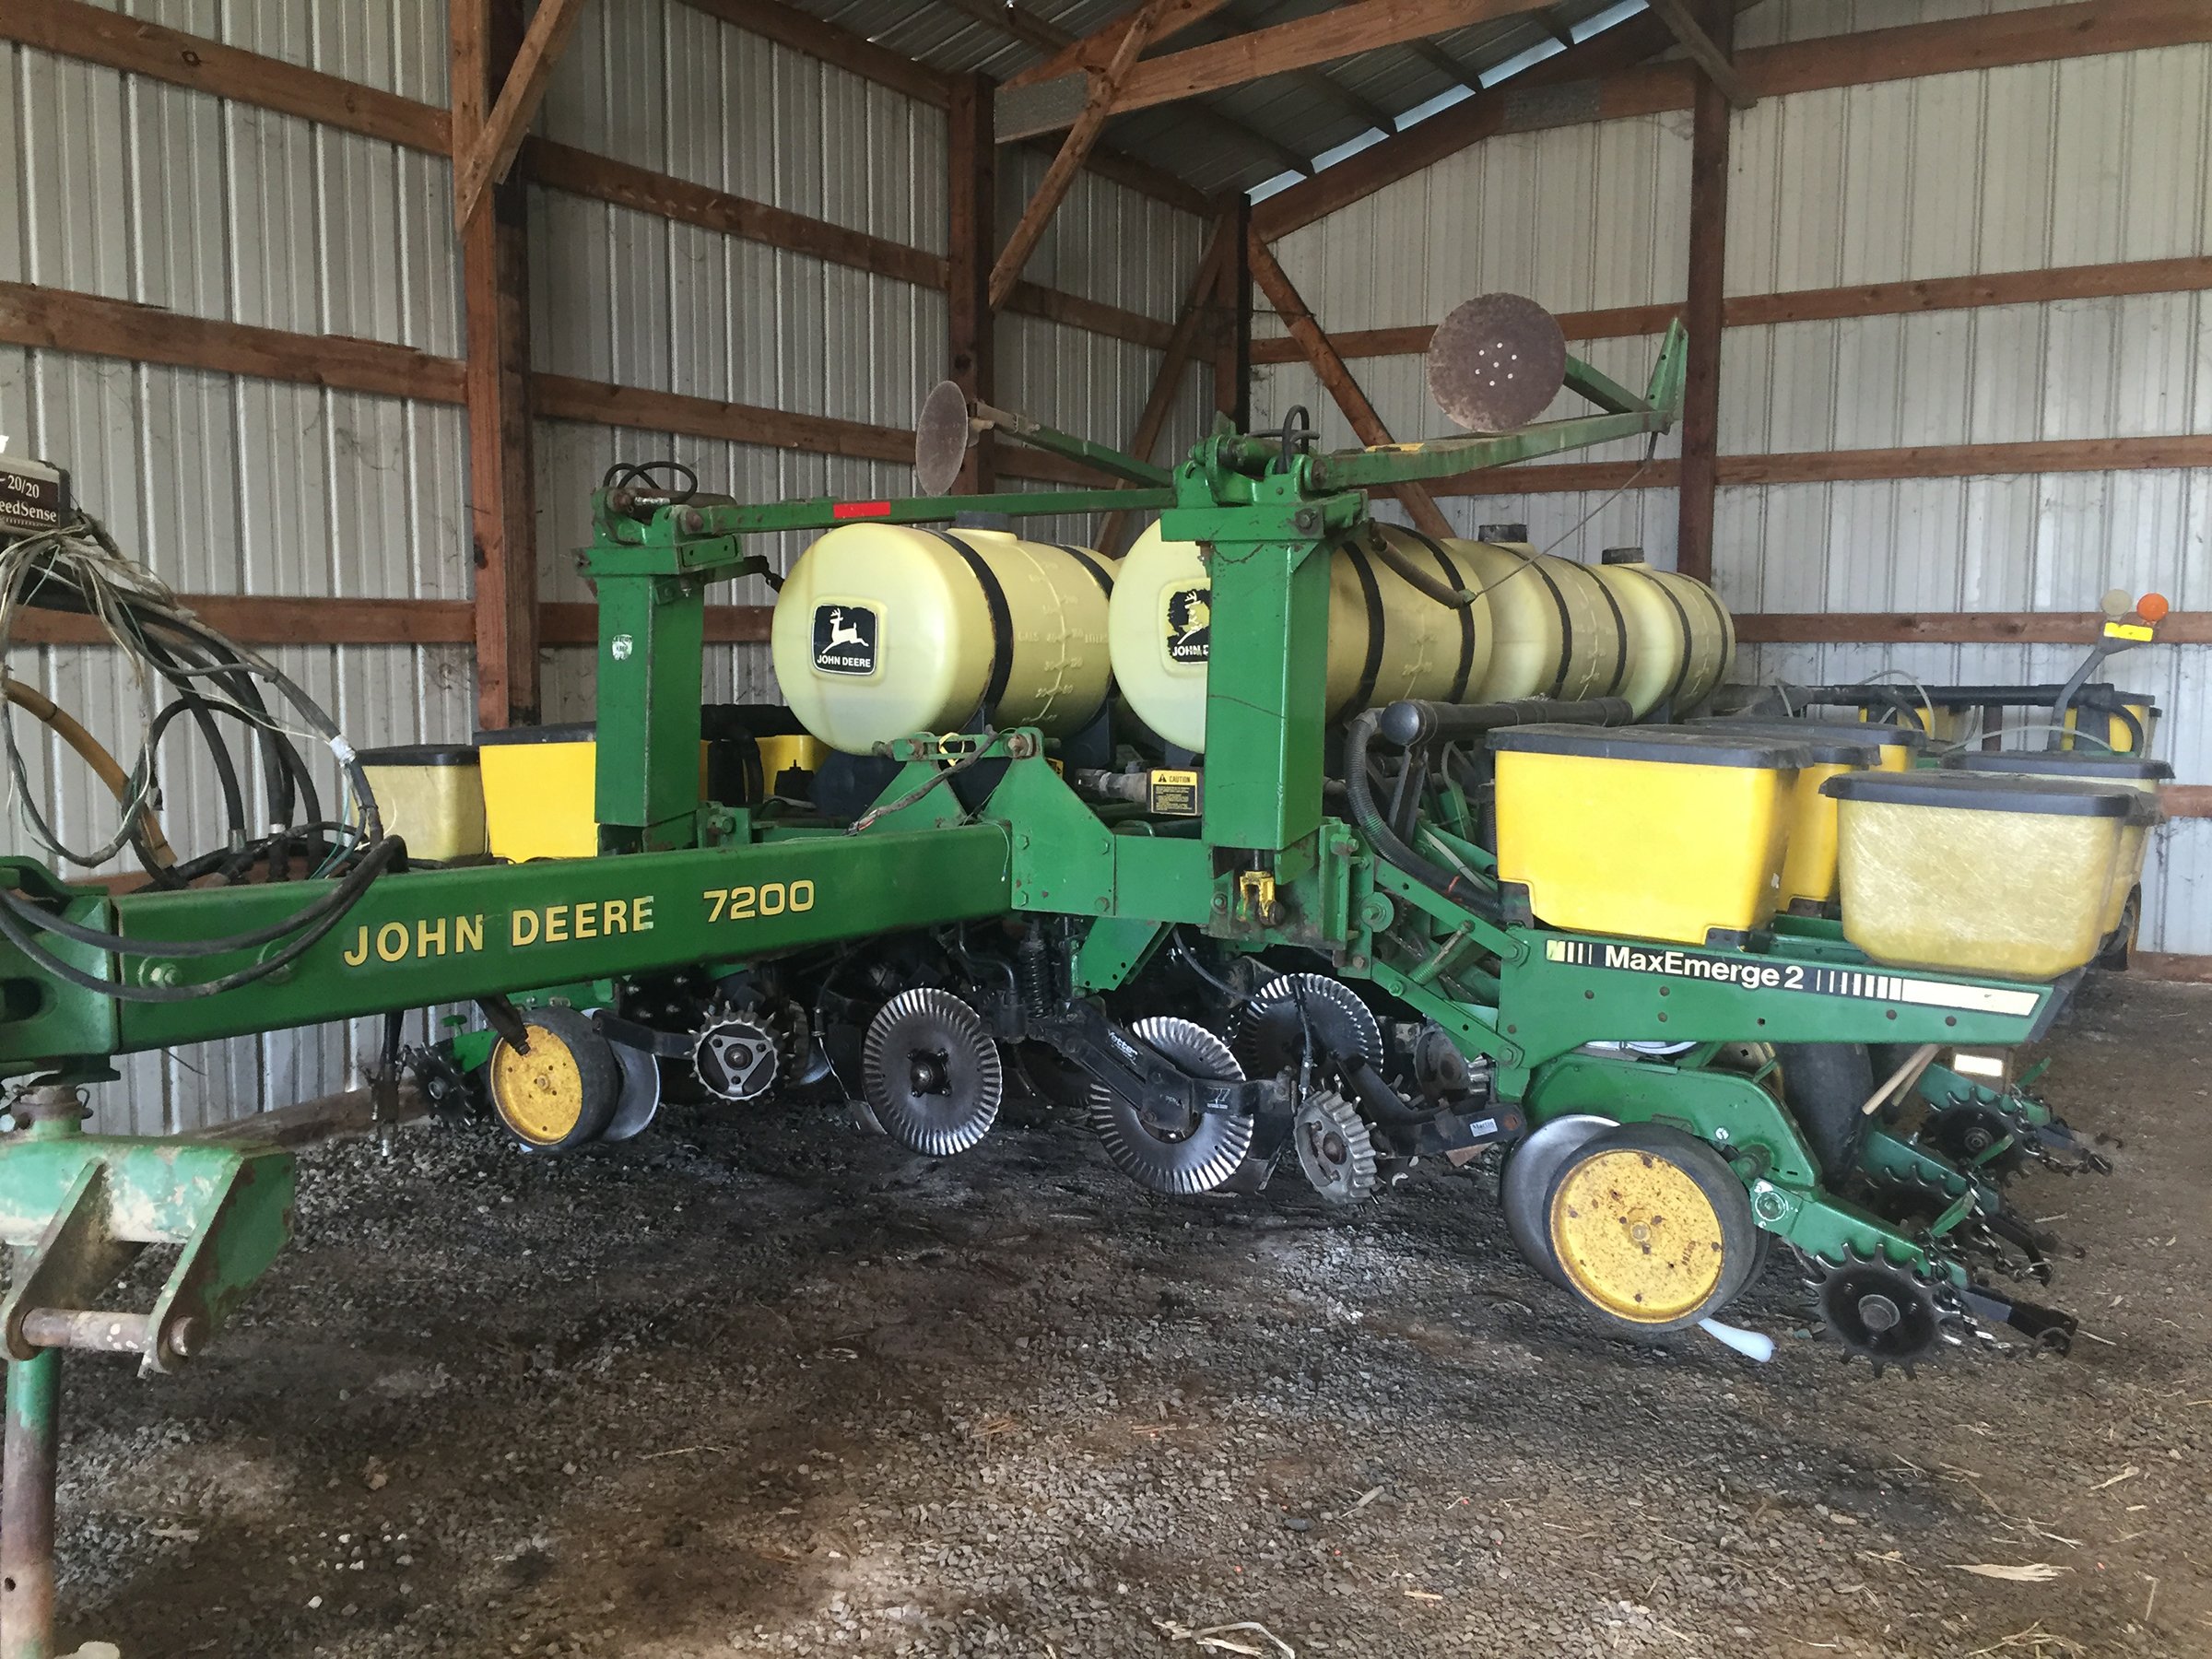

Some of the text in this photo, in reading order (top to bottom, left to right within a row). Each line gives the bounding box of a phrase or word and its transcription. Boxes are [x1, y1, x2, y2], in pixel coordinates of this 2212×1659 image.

[7, 475, 40, 499] 20/20
[1172, 645, 1202, 657] JOHN
[817, 654, 871, 668] JOHN DEERE
[1169, 775, 1191, 783] CAUTION
[343, 879, 816, 967] JOHN DEERE 7200
[1605, 945, 1804, 989] MaxEmerge 2
